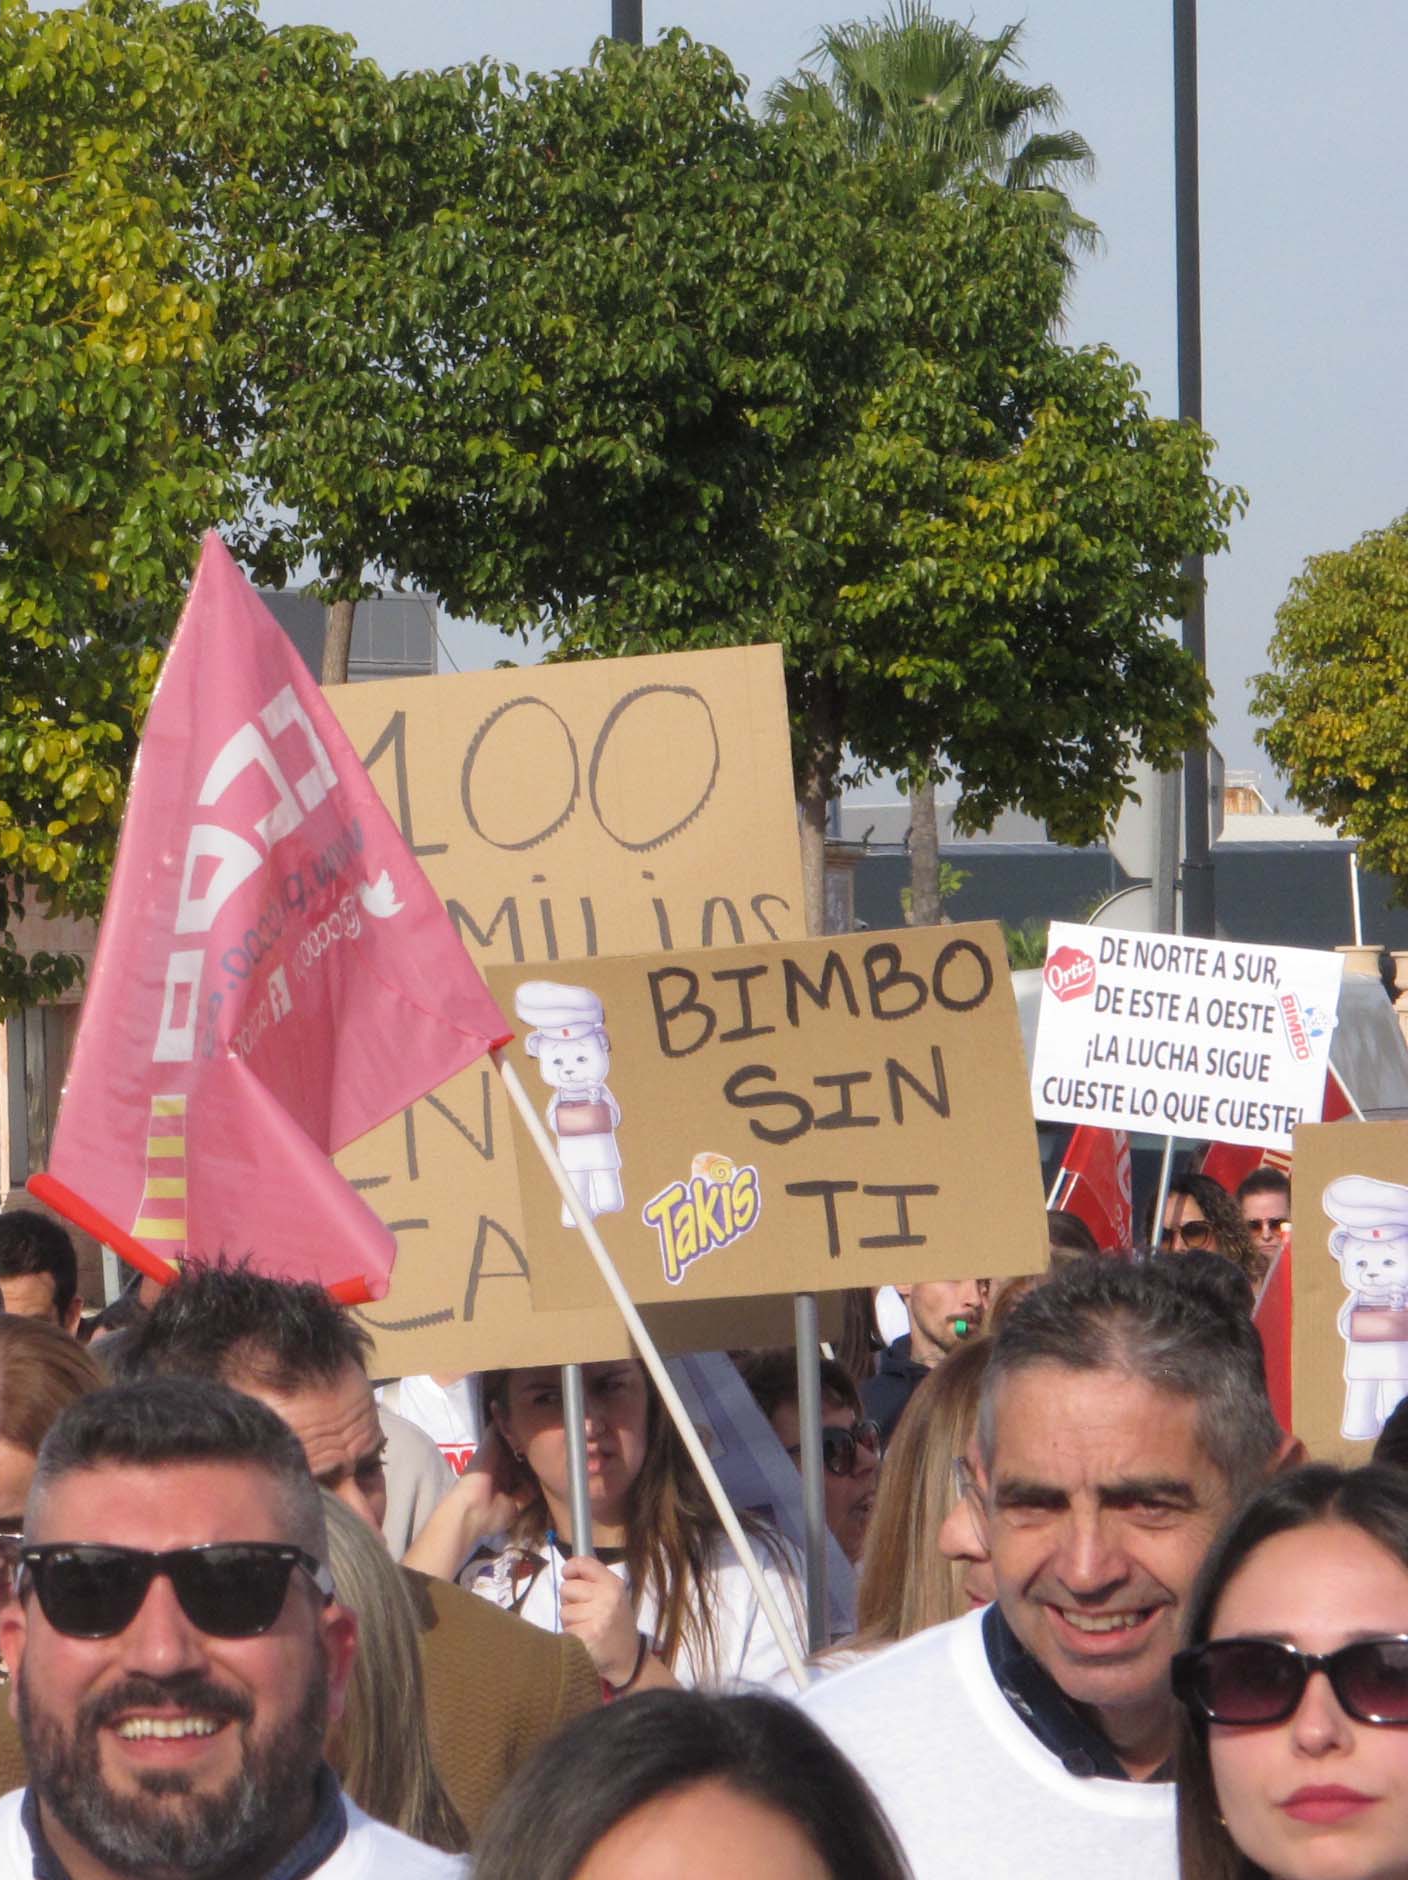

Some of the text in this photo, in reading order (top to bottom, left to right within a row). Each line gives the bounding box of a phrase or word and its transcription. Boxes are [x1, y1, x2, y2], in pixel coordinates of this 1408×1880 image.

[362, 684, 720, 857] 100
[1048, 957, 1092, 991] Ortiz
[1099, 936, 1281, 990] DE NORTE A SUR,
[648, 939, 993, 1058] BIMBO
[1094, 984, 1275, 1034] DE ESTE A OESTE
[1279, 993, 1310, 1062] BIMBO
[1085, 1033, 1272, 1082] ¡LA LUCHA SIGUE
[723, 1046, 950, 1144] SIN
[1042, 1076, 1304, 1135] CUESTE LO QUE CUESTE!
[645, 1167, 759, 1282] Takis
[786, 1180, 939, 1259] TI
